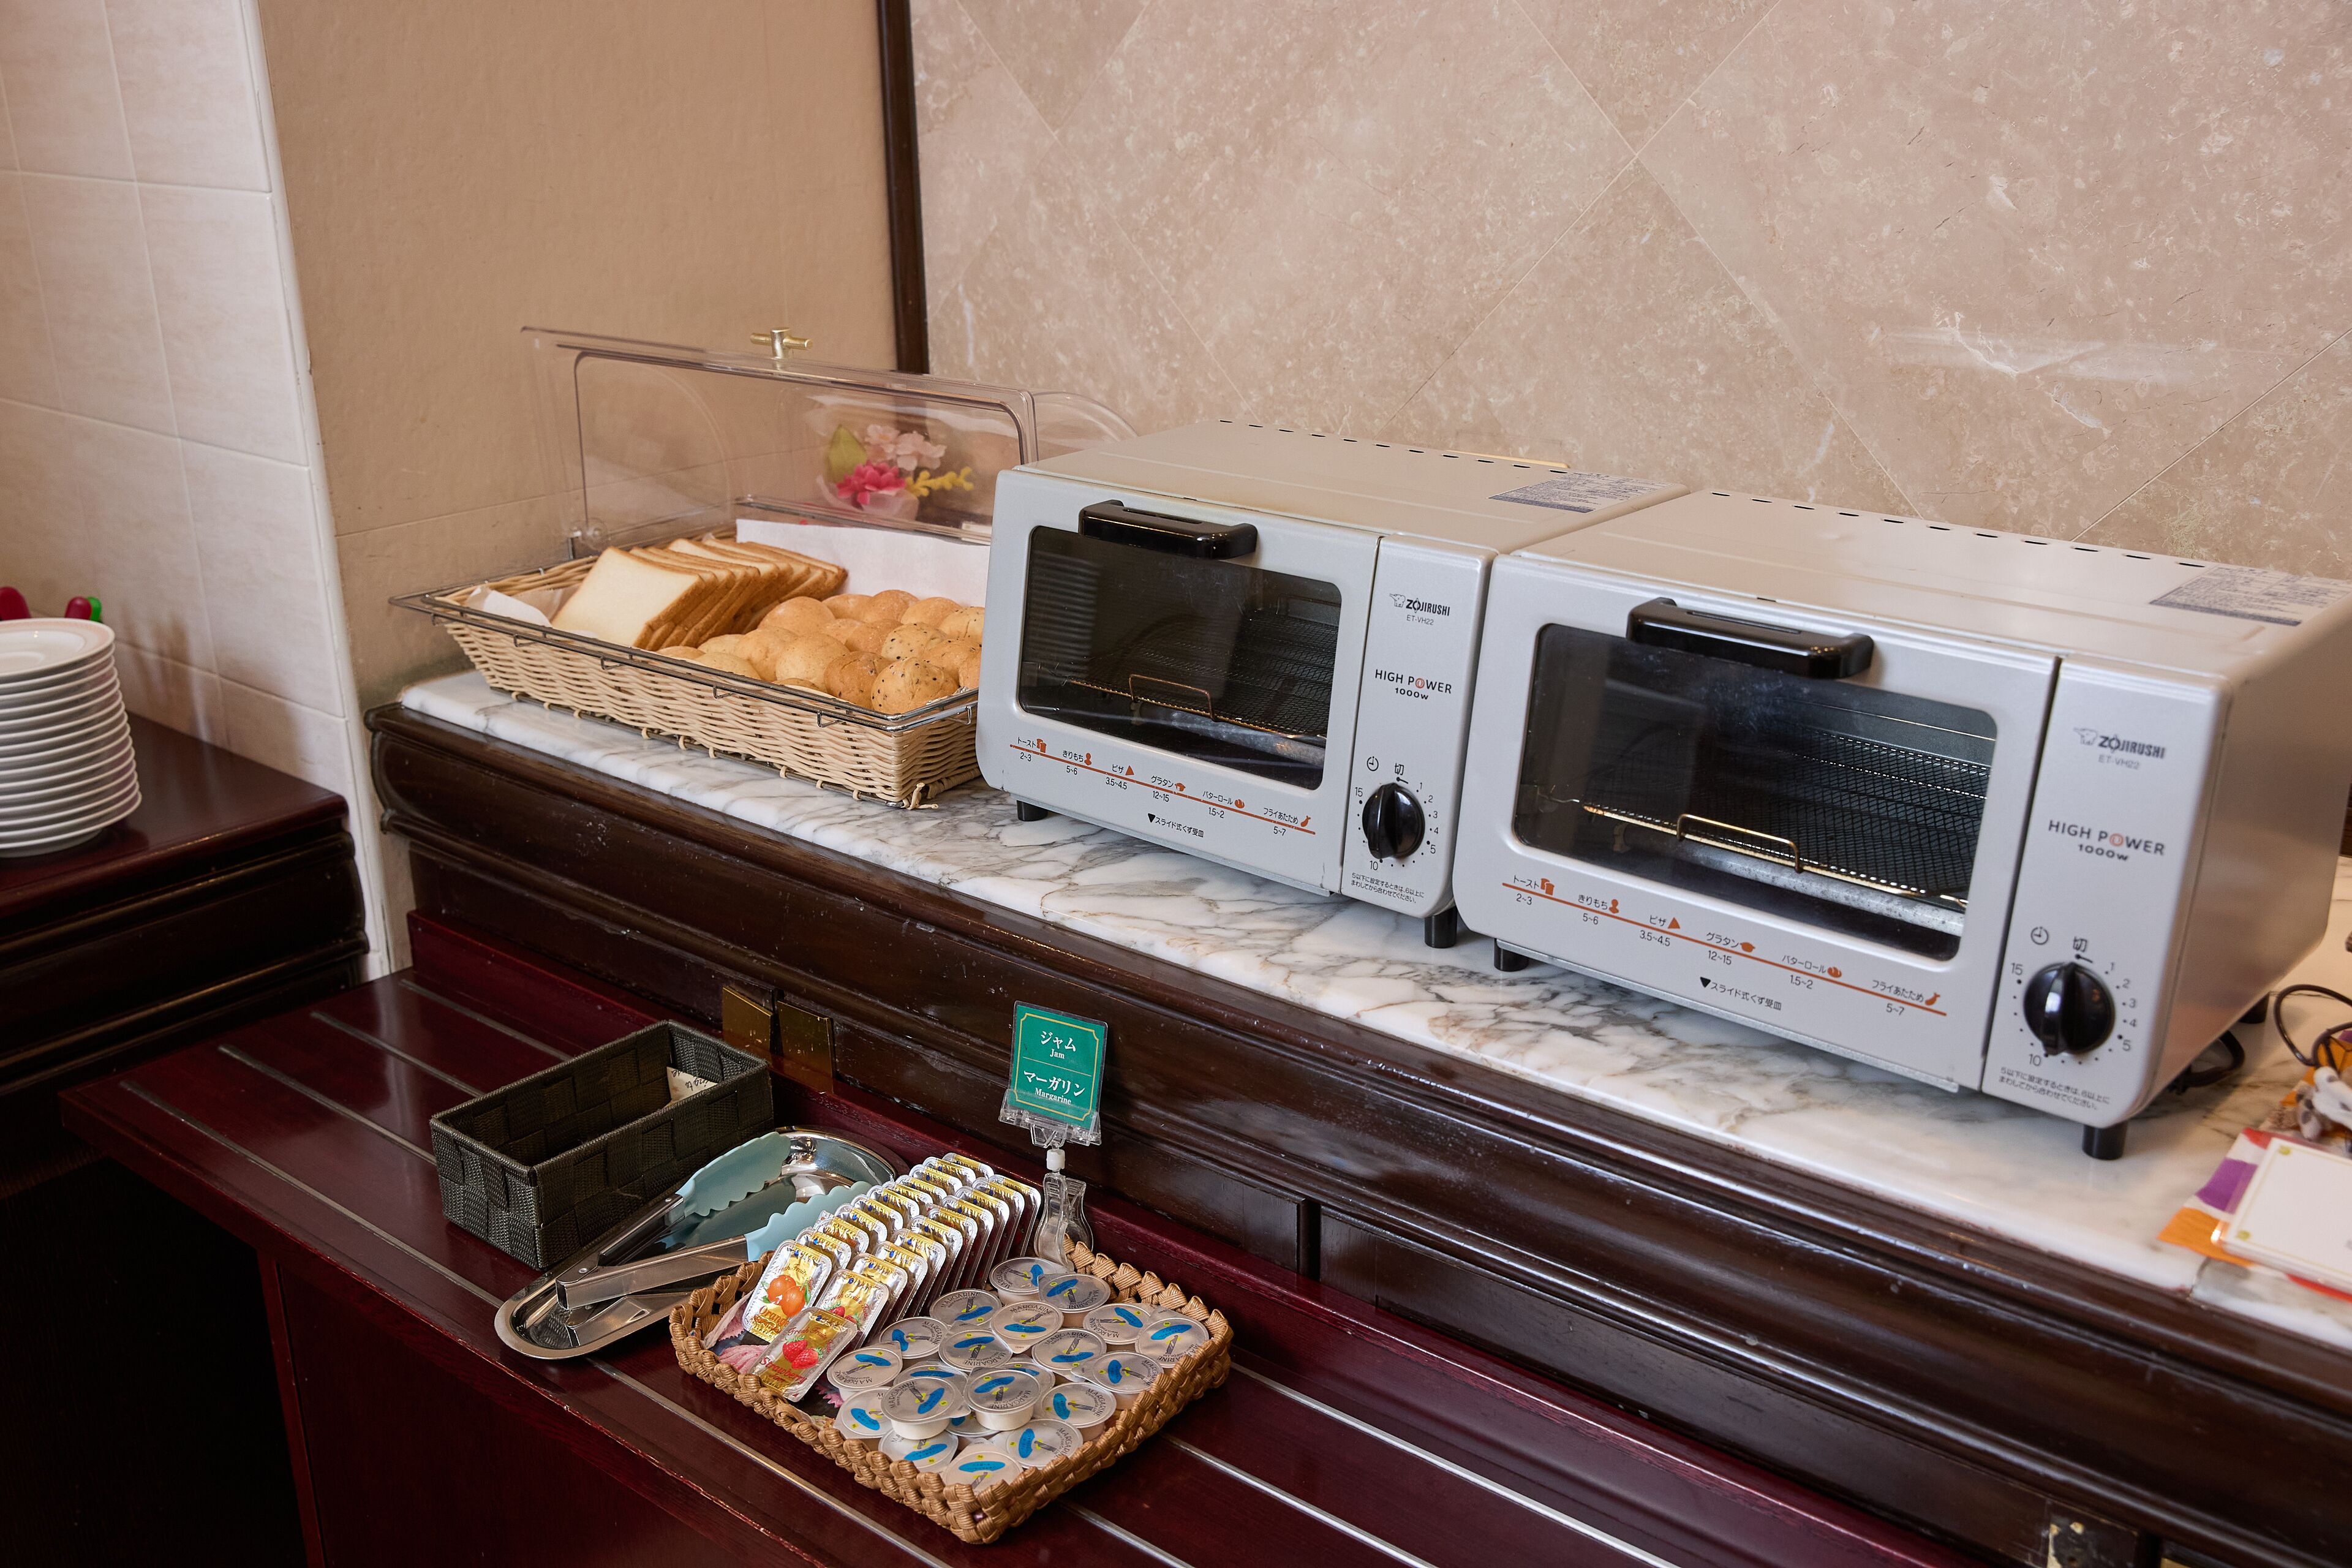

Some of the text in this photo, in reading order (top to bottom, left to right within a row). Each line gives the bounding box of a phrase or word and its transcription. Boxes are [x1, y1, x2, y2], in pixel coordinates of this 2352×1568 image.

[1406, 597, 1450, 617] ZOJIRUSHI
[1406, 614, 1434, 626] ET-VH22
[1374, 668, 1452, 695] HIGH POWER
[1017, 737, 1036, 748] トースト
[2097, 732, 2167, 760] ZOJIRUSHI
[1062, 749, 1084, 763] きりもち
[1395, 763, 1404, 775] 切
[1150, 774, 1175, 789] グラタン
[1202, 790, 1234, 805] バターロール
[1354, 786, 1363, 797] 15
[1428, 795, 1434, 804] 2
[1263, 807, 1299, 824] フライあたため
[1432, 810, 1438, 819] 3
[1434, 826, 1439, 835] 4
[2048, 820, 2166, 856] HIGH POWER
[1430, 844, 1436, 854] 5
[1369, 861, 1379, 871] 10
[1512, 873, 1540, 890] トースト
[1577, 892, 1608, 911] きりもち
[1705, 931, 1740, 949] グラタン
[2073, 937, 2088, 953] 切
[1781, 954, 1826, 974] バターロール
[2011, 962, 2024, 975] 15
[2109, 962, 2116, 972] 1
[2122, 978, 2130, 989] 2
[1871, 979, 1924, 1004] フライあたため
[2128, 998, 2137, 1009] 3
[2128, 1017, 2138, 1028] 4
[1040, 1030, 1077, 1052] ジャム
[2122, 1039, 2132, 1052] 5
[1049, 1048, 1065, 1060] Jam
[2027, 1054, 2042, 1067] 10
[1023, 1069, 1086, 1097] マーガリン
[1034, 1087, 1072, 1106] Margarine
[941, 1291, 981, 1308] MARGARINE
[1009, 1304, 1054, 1316] MARGARINE
[788, 1327, 828, 1340] Fresh Fruits
[922, 1321, 943, 1346] MARGARINE
[1089, 1317, 1120, 1338] MARGARINE
[1044, 1332, 1090, 1346] MARGARINE
[962, 1352, 1006, 1366] MARGARINE
[760, 1356, 807, 1384] Strawberry
[834, 1370, 873, 1385] MARGARINE
[768, 1373, 785, 1383] Jam
[889, 1381, 917, 1409] MARGARINE
[989, 1390, 1031, 1409] MARGARINE
[1086, 1389, 1106, 1417] MARGARINE
